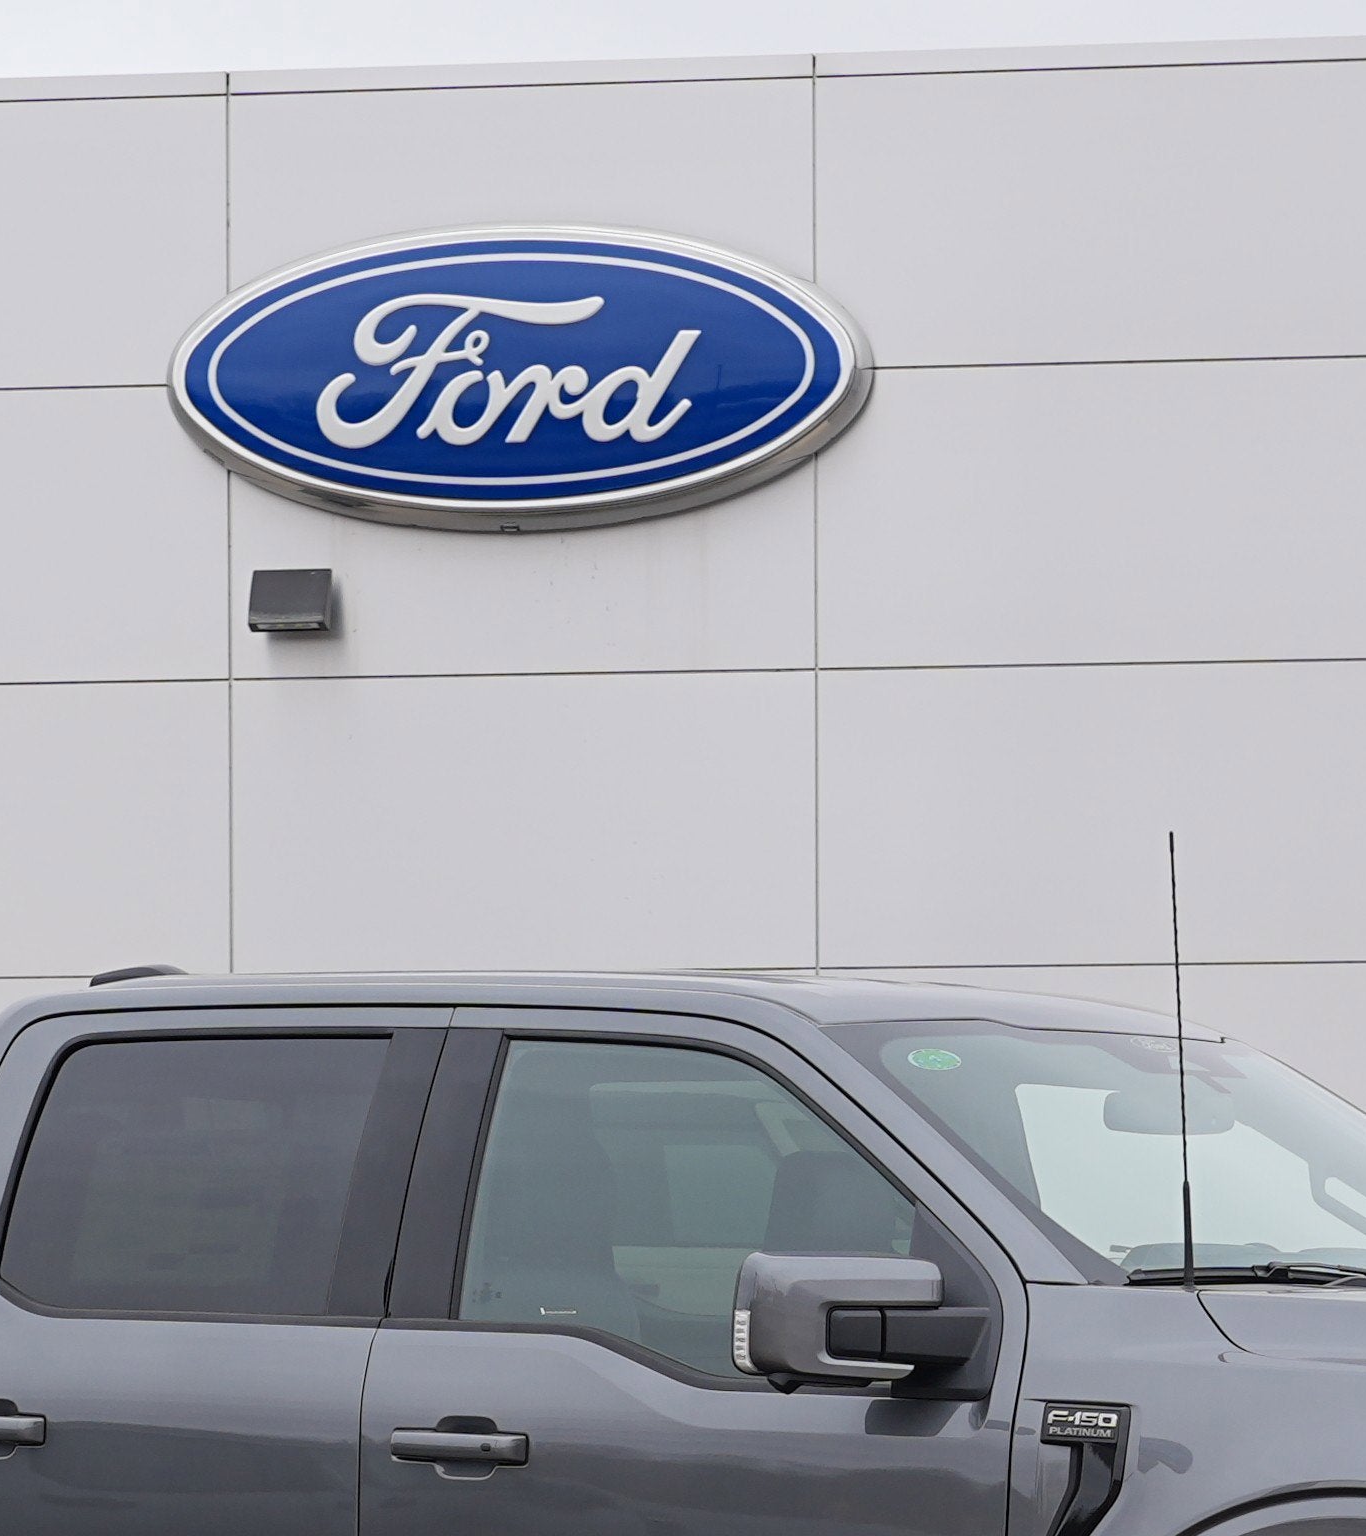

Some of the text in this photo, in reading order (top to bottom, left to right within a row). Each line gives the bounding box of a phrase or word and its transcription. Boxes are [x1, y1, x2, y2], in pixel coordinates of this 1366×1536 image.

[315, 292, 702, 449] Ford
[1047, 1409, 1119, 1427] F-150
[1047, 1426, 1112, 1438] PLATINUM
